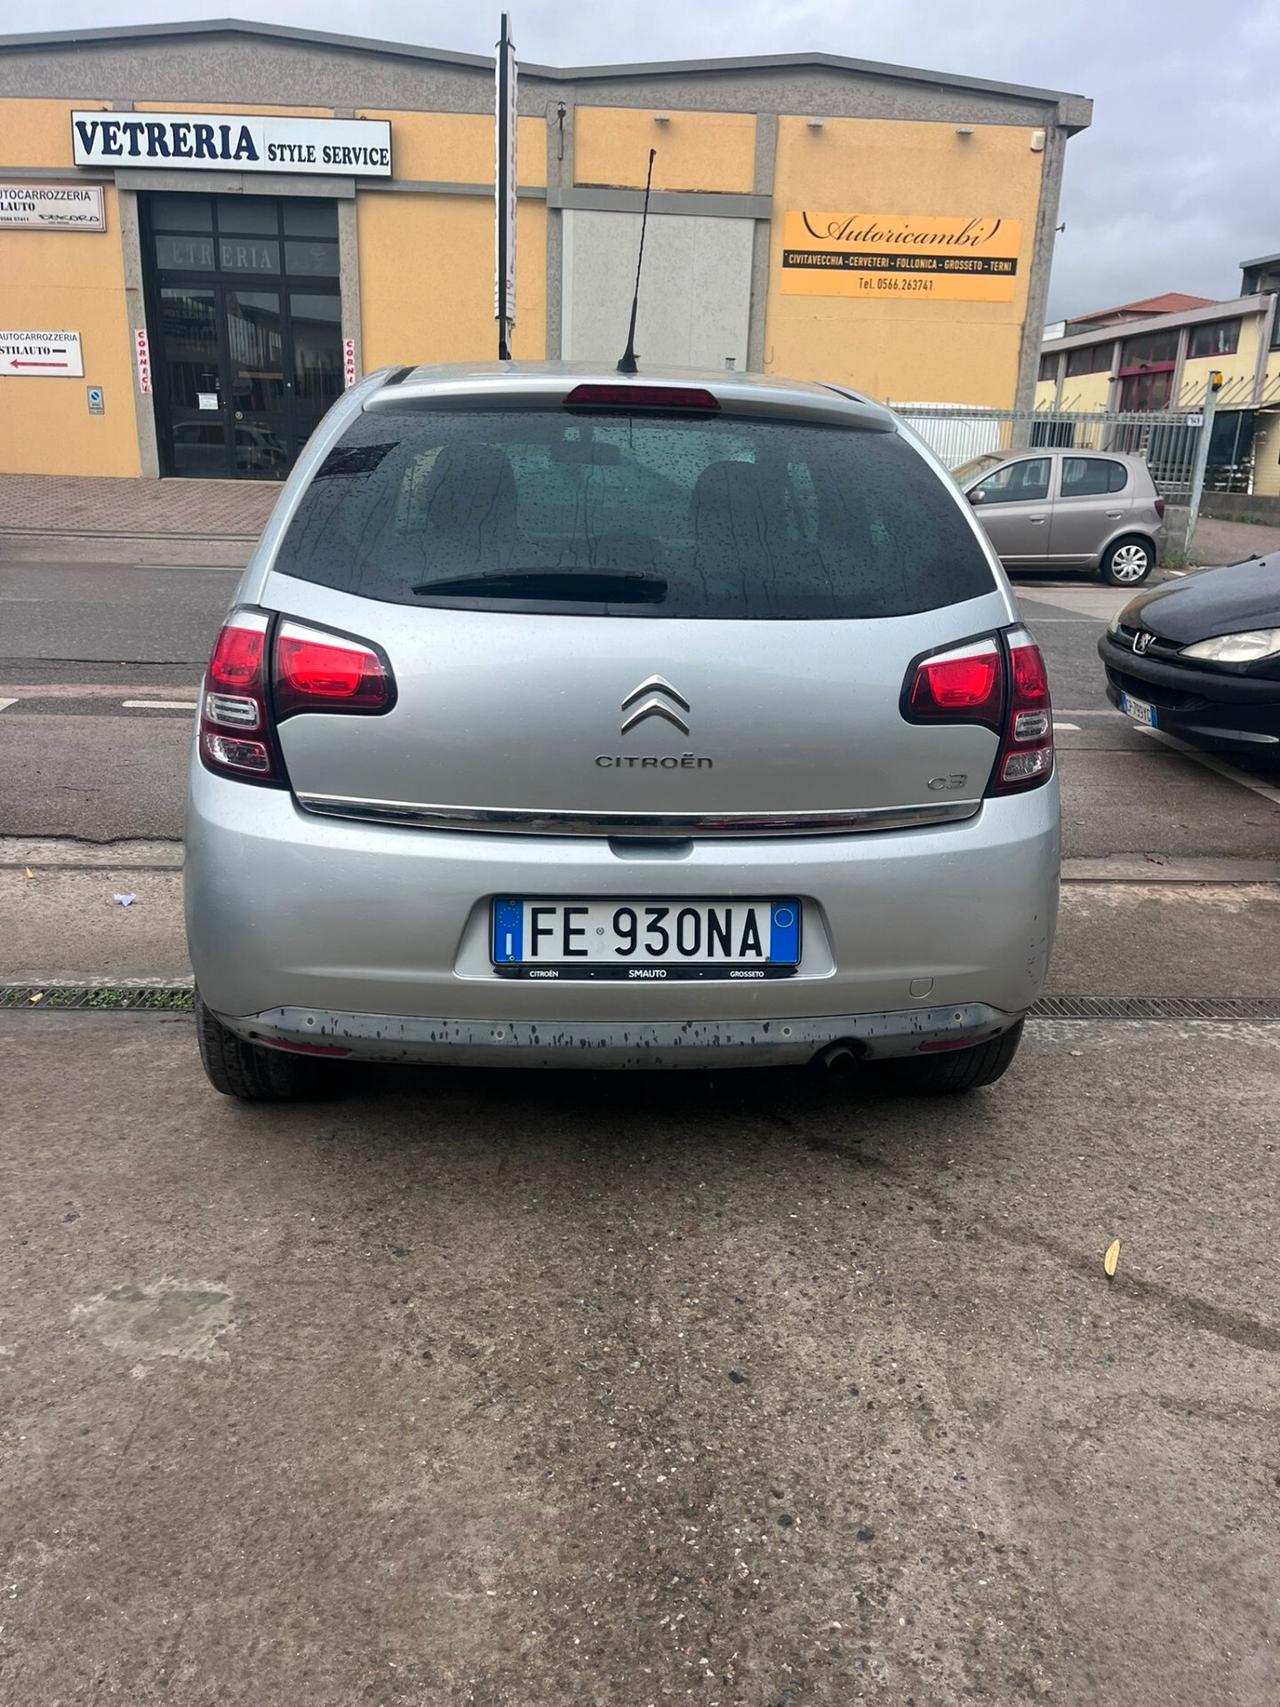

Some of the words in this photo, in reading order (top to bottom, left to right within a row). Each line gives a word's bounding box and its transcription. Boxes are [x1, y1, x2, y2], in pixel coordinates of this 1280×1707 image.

[75, 121, 260, 161] VETRERIA
[267, 143, 316, 163] STYLE
[322, 145, 390, 167] SERVICE
[0, 202, 35, 212] LAUTO
[824, 215, 985, 247] Autoricambi
[896, 258, 937, 269] FOLLONICA
[944, 259, 983, 271] GROSSETO
[990, 261, 1012, 272] TERNI
[346, 340, 354, 383] CORNI
[530, 907, 589, 957] FE
[612, 906, 763, 958] 930NA
[628, 969, 667, 978] SMAUTO
[729, 970, 765, 978] GROSSETO
